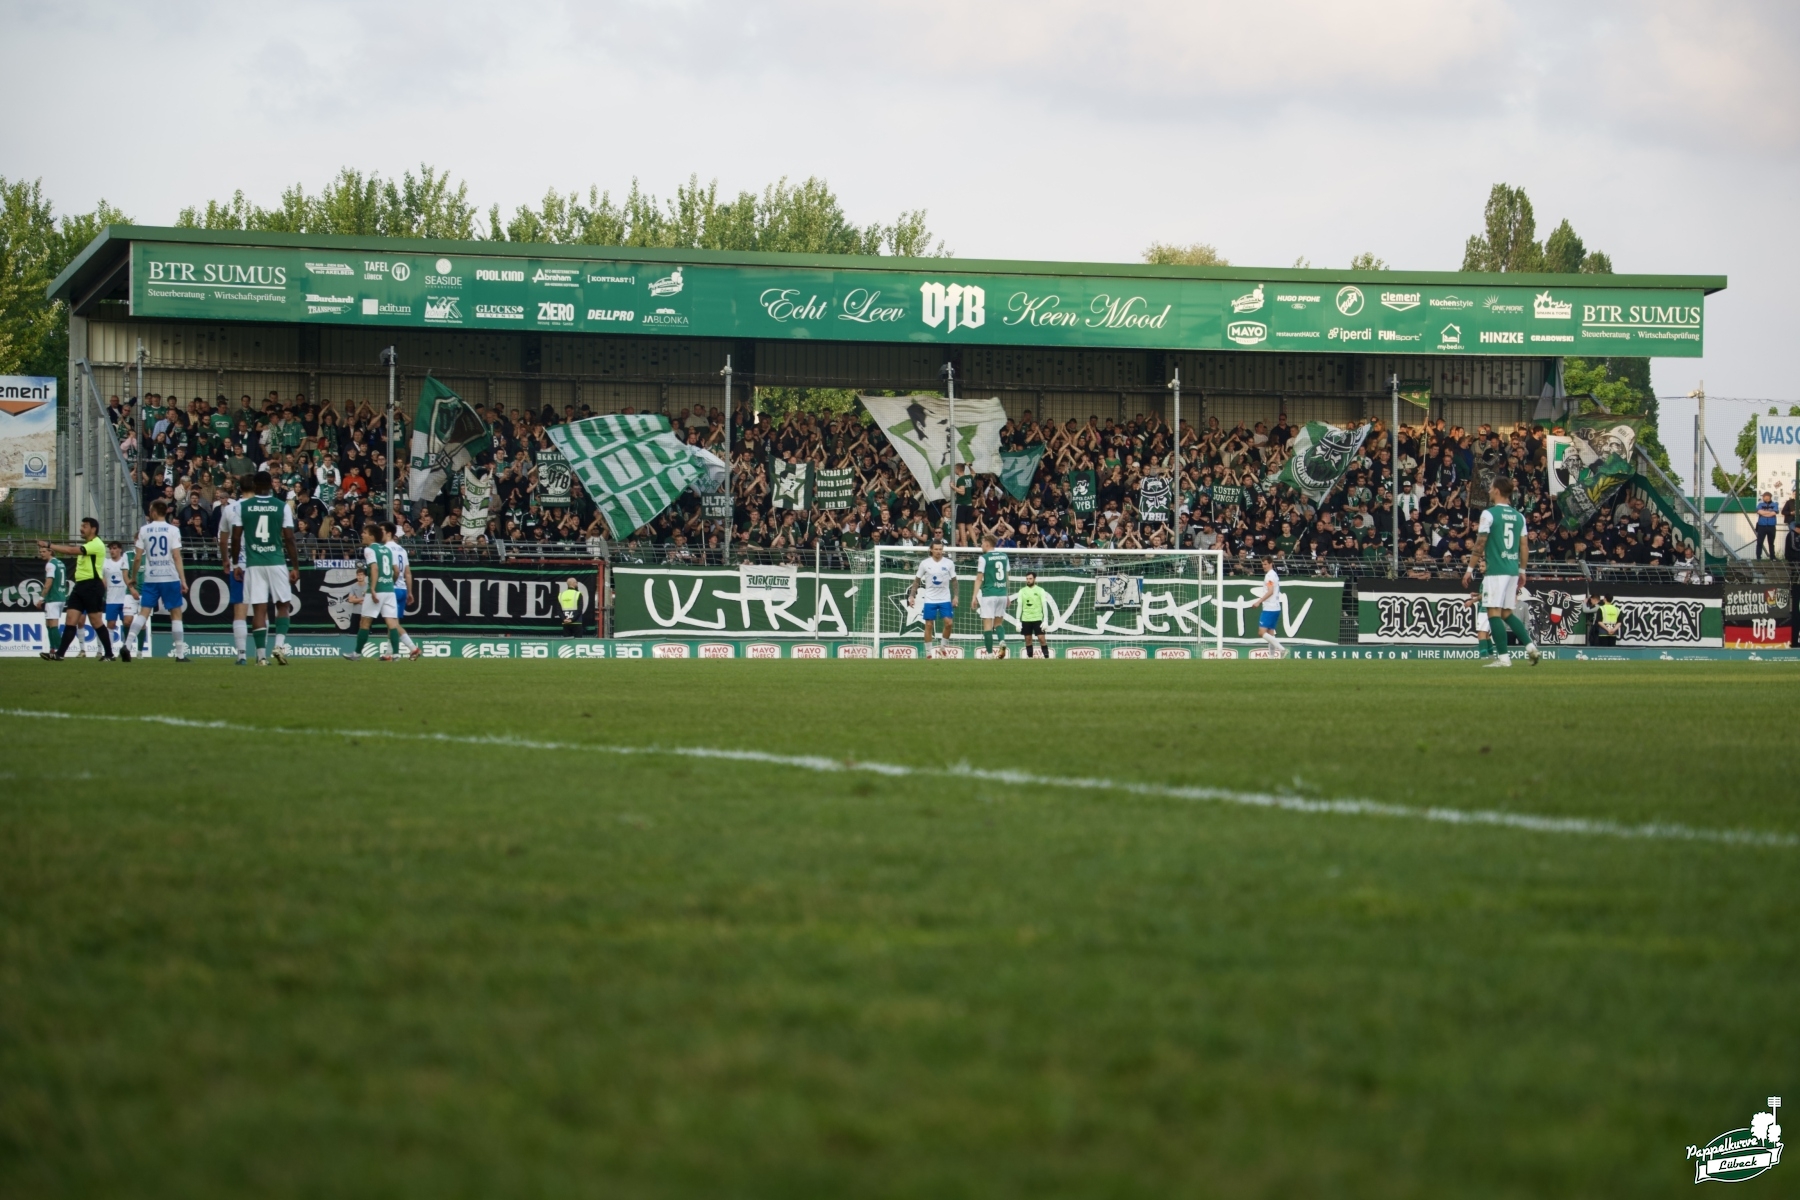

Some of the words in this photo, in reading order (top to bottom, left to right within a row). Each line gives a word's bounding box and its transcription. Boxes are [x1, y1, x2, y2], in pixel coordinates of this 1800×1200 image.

[148, 261, 196, 280] BTR
[204, 264, 286, 284] SUMUS
[364, 261, 390, 272] TAFEL
[425, 276, 462, 286] SEASIDE
[148, 288, 205, 300] Steuerberatung
[214, 291, 286, 304] Wirtschaftsprüfung
[314, 295, 354, 304] Burchardt
[1381, 292, 1420, 302] clement
[380, 303, 412, 312] aditum
[760, 288, 828, 322] Echt
[838, 288, 905, 322] Leev
[920, 281, 985, 334] VfB
[1003, 291, 1080, 327] Keen
[1085, 295, 1172, 329] Mood
[587, 310, 634, 322] DELLPRO
[642, 315, 689, 324] JABLONKA
[1582, 305, 1623, 322] BTR
[1629, 306, 1700, 324] SUMUS
[1232, 326, 1264, 336] MAYO
[1340, 328, 1372, 342] iperdi
[1582, 330, 1630, 340] Steuerberatung
[1638, 331, 1700, 341] Wirtschaftsprüfung
[1480, 332, 1524, 344] HINZKE
[1213, 486, 1241, 495] KÜSTEN
[1213, 493, 1234, 502] JUNGS
[1141, 512, 1168, 522] VBHL
[256, 515, 270, 543] 4
[1504, 522, 1514, 550] 5
[149, 536, 168, 557] 29
[316, 558, 356, 570] SEKTION
[382, 554, 391, 576] 8
[398, 554, 404, 572] 8
[60, 569, 66, 586] 1
[995, 561, 1005, 582] 3
[1727, 590, 1764, 604] sektion
[1725, 602, 1768, 616] neustadt
[294, 646, 340, 656] HOLSTEN
[422, 644, 451, 657] 30
[480, 644, 510, 656] FLS
[520, 646, 548, 658] 30
[576, 644, 605, 656] FLS
[615, 647, 642, 658] 30
[1294, 650, 1408, 659] KENSINGTON
[1418, 650, 1440, 659] IHRE
